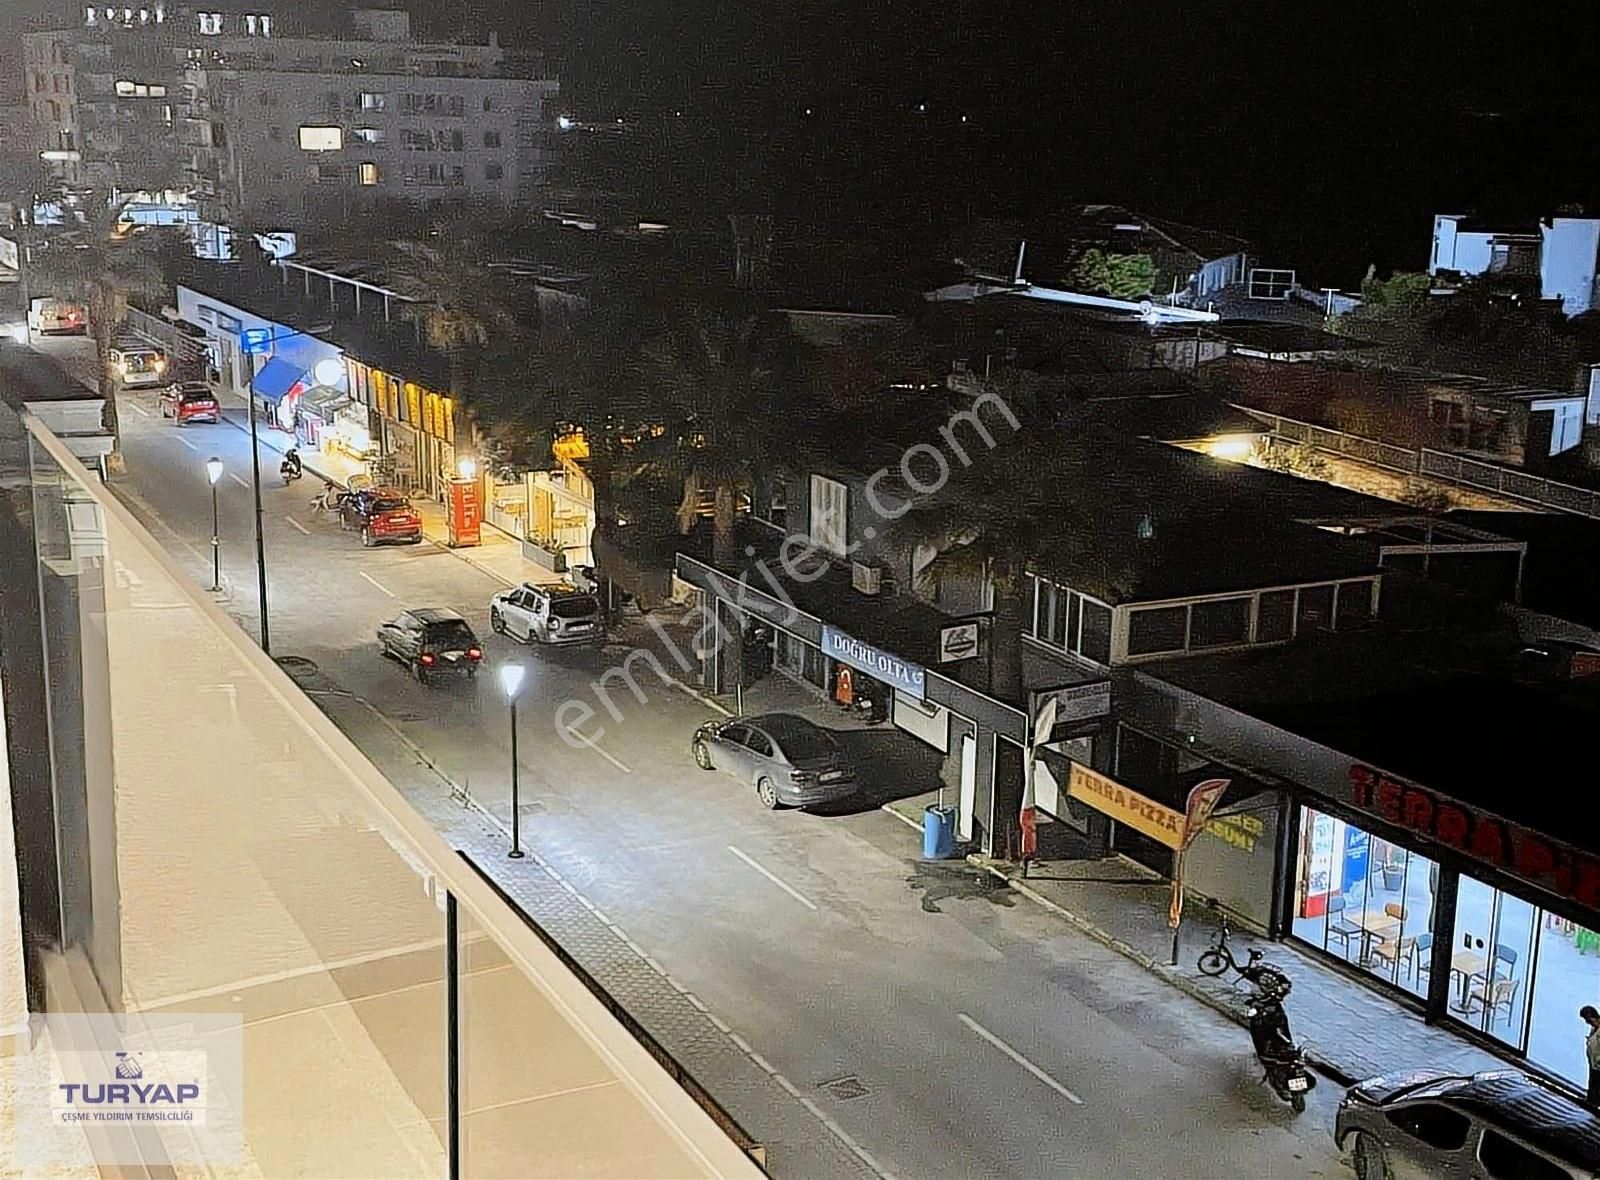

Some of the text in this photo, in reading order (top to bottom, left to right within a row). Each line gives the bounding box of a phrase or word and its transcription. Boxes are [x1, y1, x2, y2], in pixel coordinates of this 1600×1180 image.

[833, 634, 910, 684] DOĞRU OLTA
[1075, 769, 1126, 808] TERRA
[1349, 763, 1503, 868] TERRA
